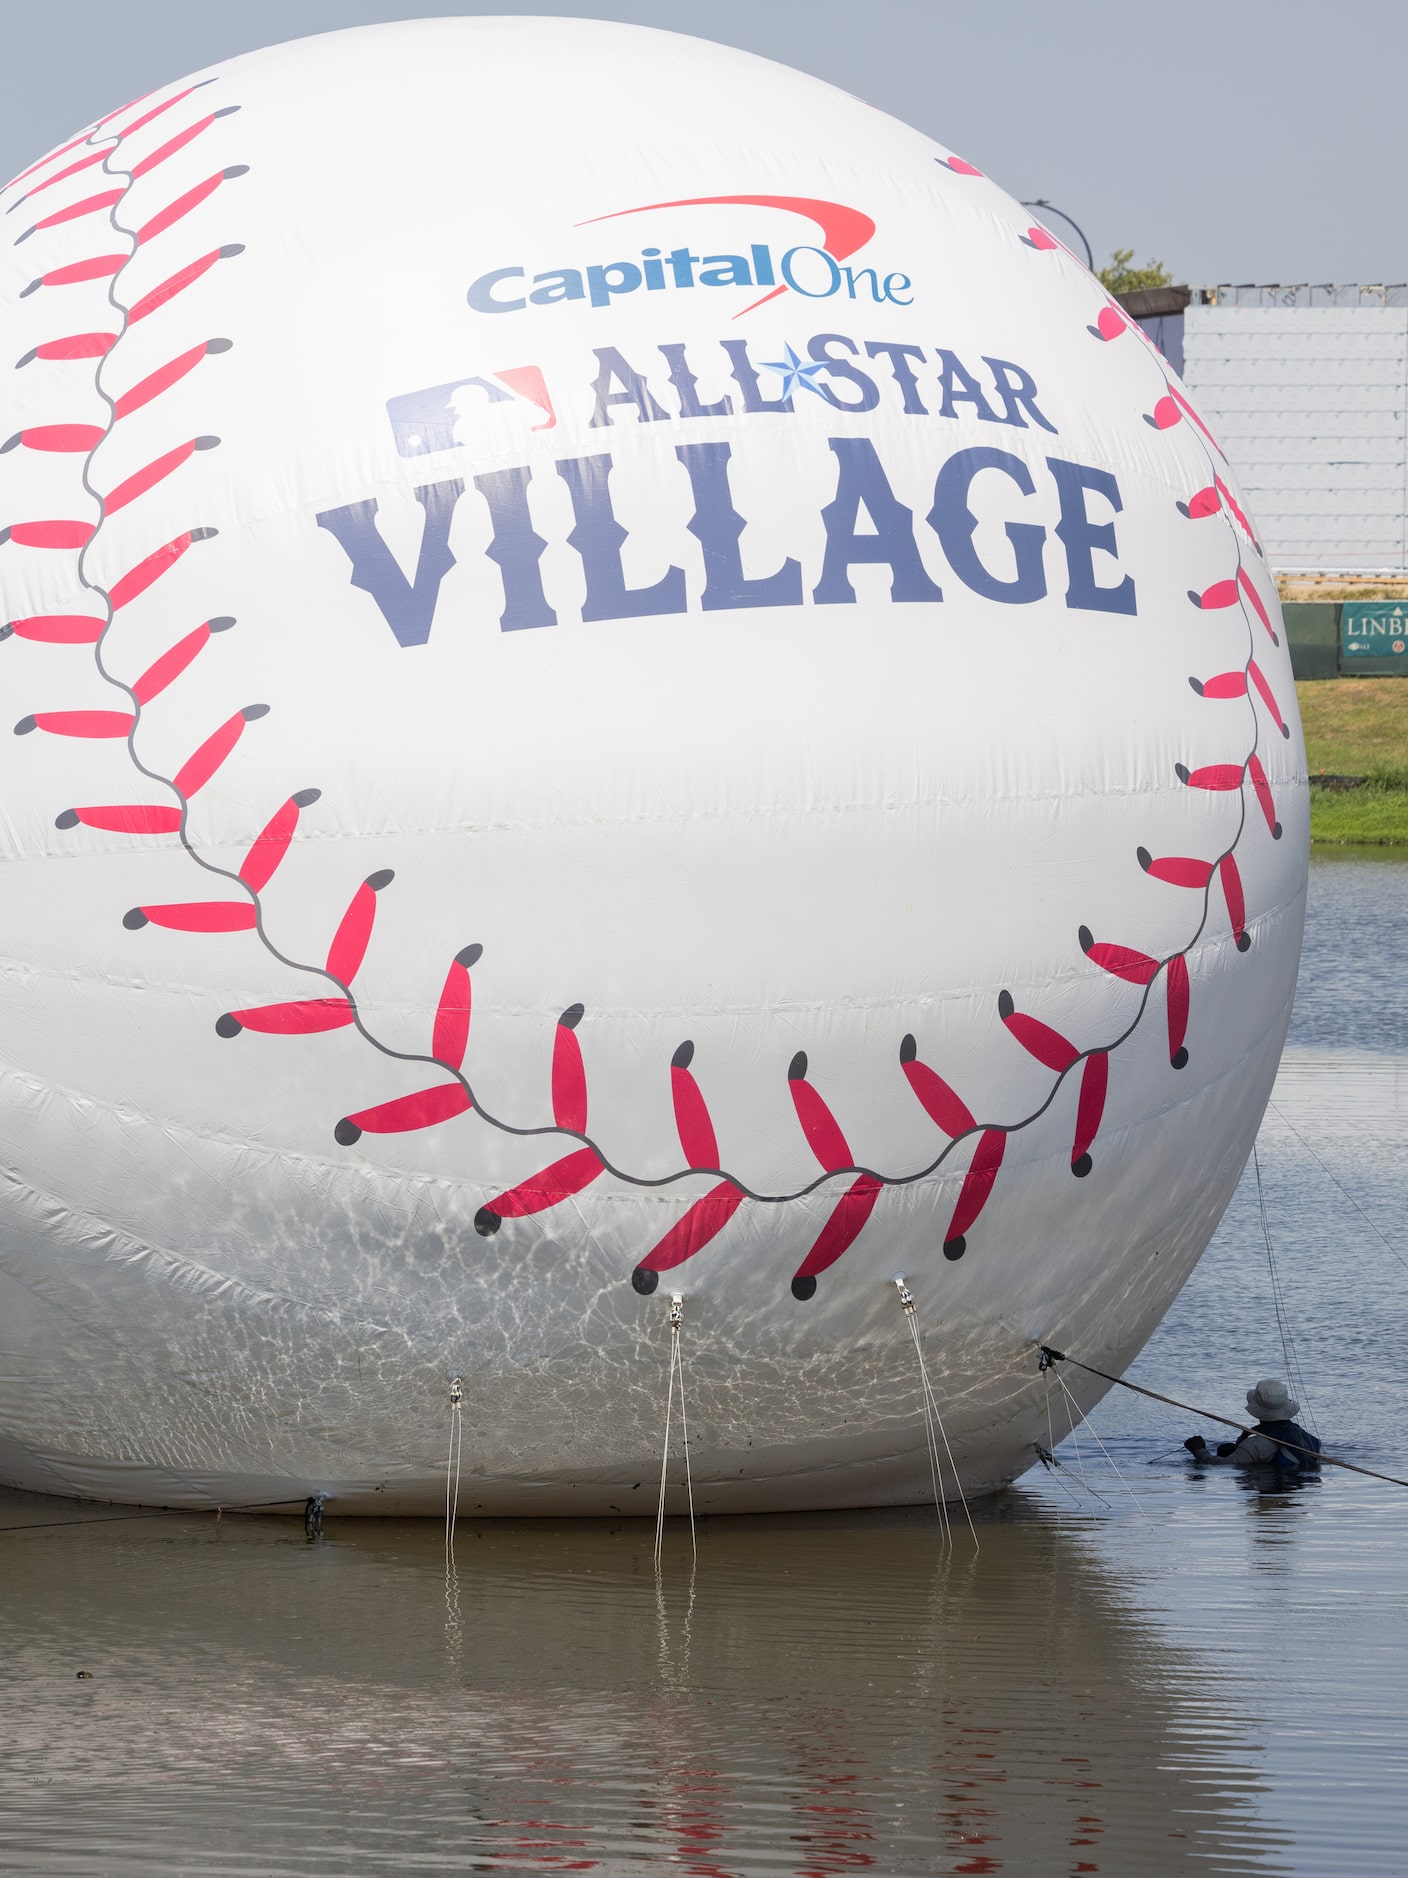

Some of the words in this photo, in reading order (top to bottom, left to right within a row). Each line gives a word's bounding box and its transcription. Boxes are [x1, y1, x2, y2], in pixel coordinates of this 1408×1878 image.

[588, 338, 796, 429] ALL
[818, 332, 1059, 436] STAR
[315, 437, 1138, 649] VILLAGE
